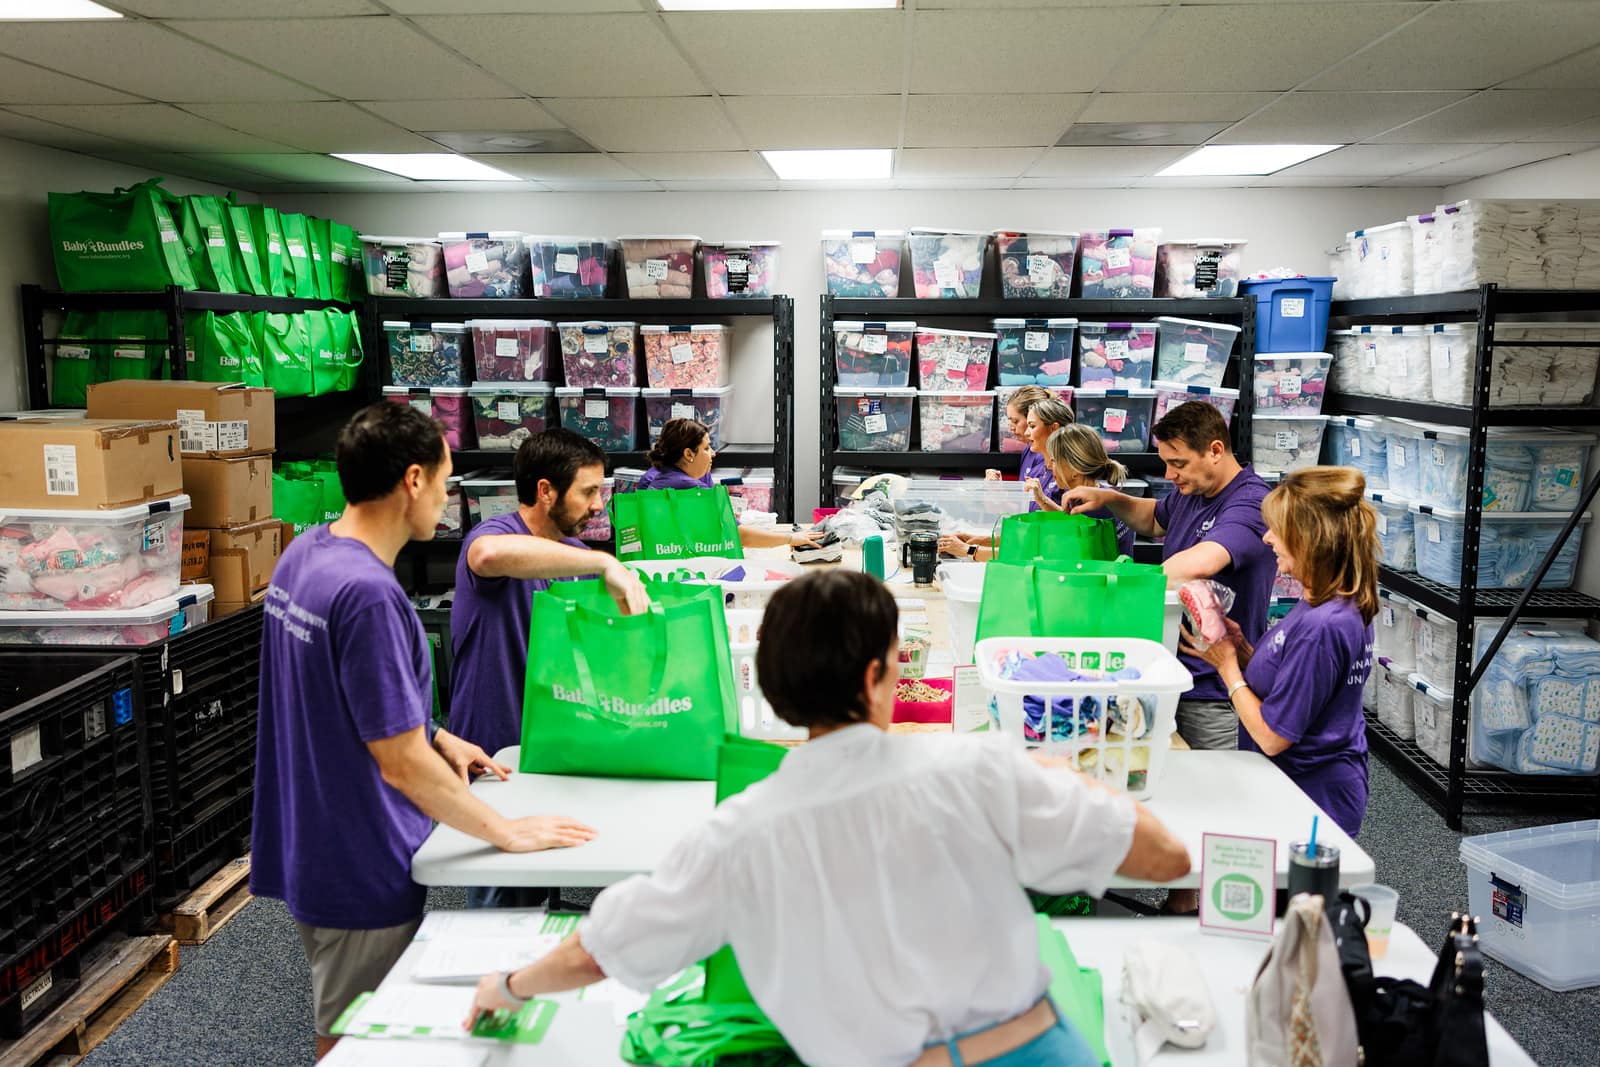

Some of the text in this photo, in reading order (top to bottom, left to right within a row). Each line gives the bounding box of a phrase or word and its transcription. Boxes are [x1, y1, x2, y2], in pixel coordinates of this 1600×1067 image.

[63, 240, 144, 253] Baby Bundles
[656, 540, 735, 556] Baby Bunles
[553, 684, 588, 706] Bab
